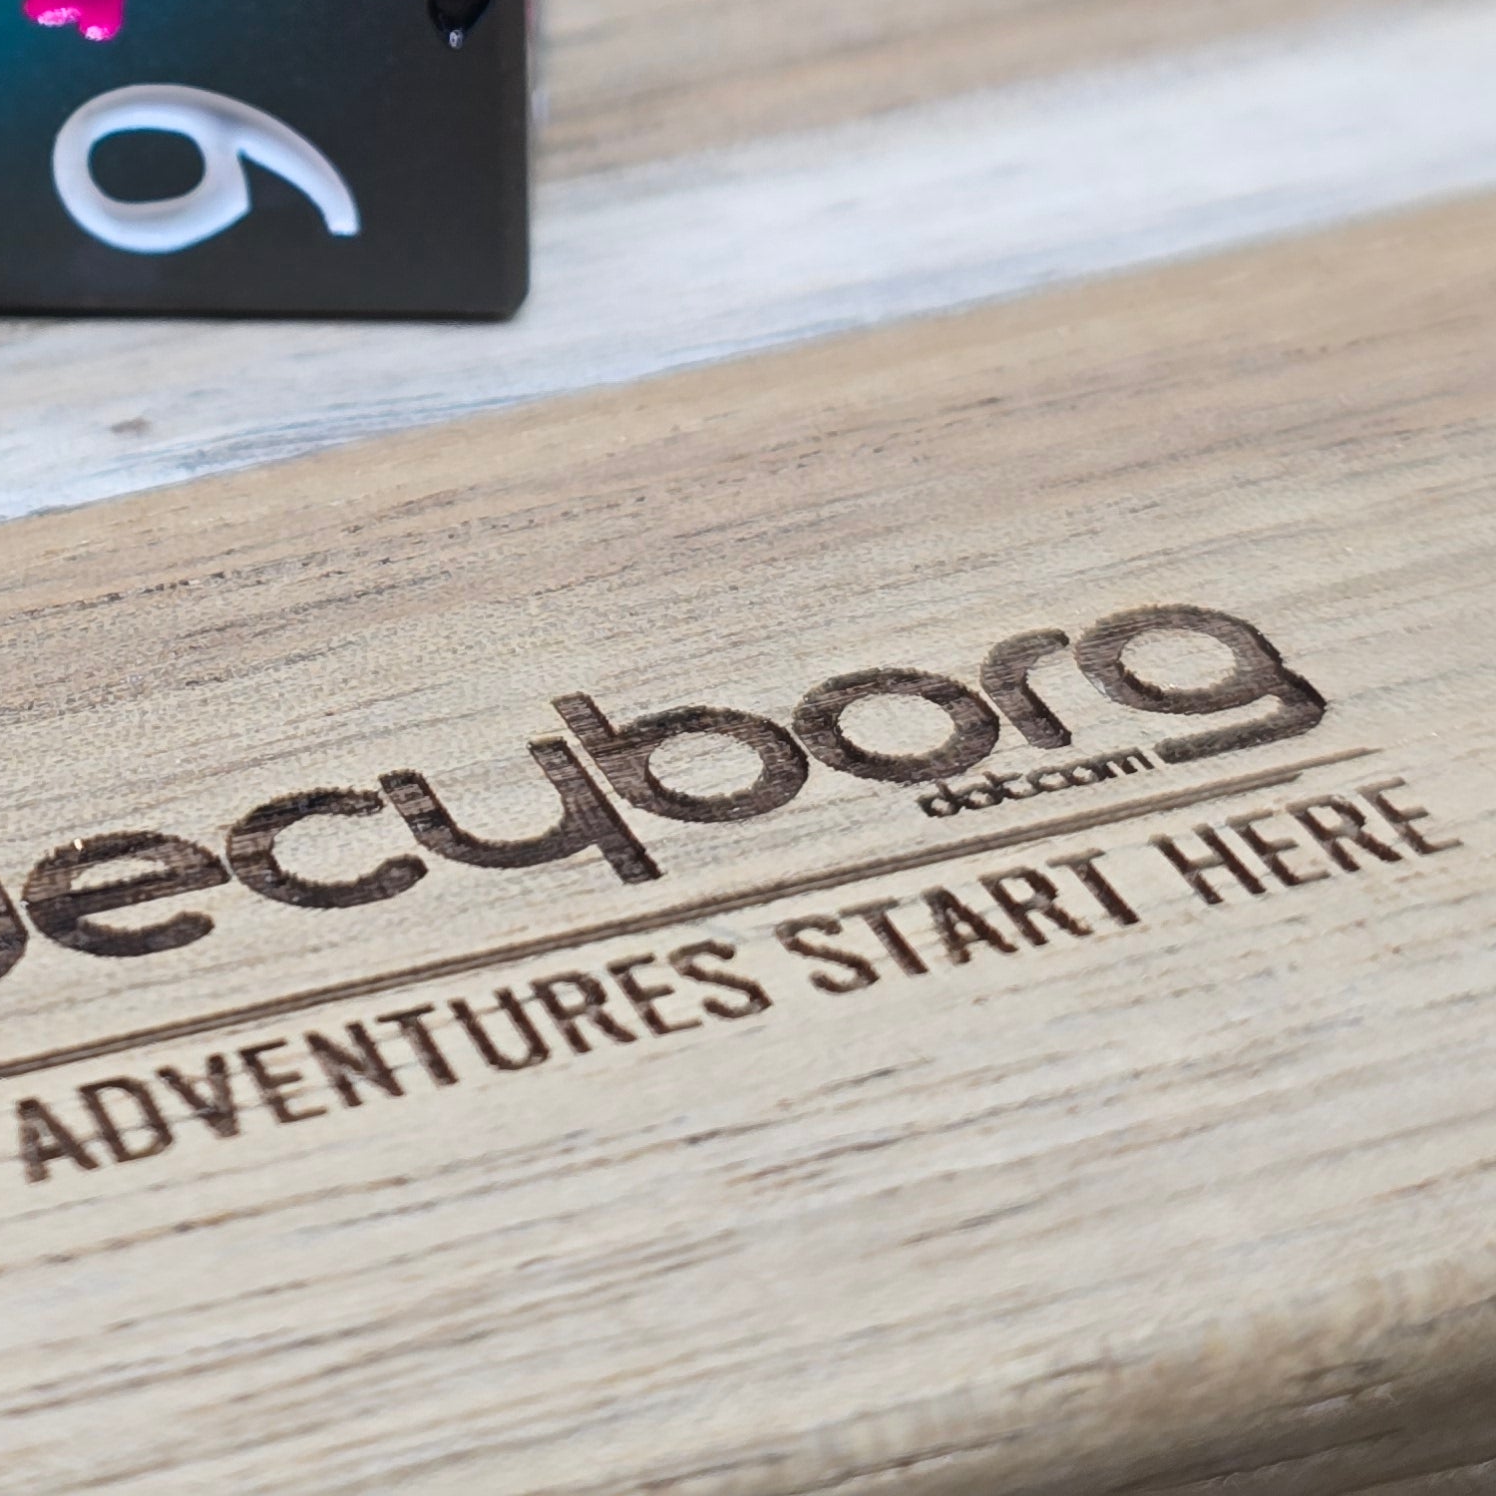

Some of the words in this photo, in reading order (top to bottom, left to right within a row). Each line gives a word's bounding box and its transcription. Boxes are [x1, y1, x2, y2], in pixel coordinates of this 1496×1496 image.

[12, 938, 776, 1186] ADVENTURES
[774, 846, 1142, 996] START
[1150, 776, 1464, 908] HERE
